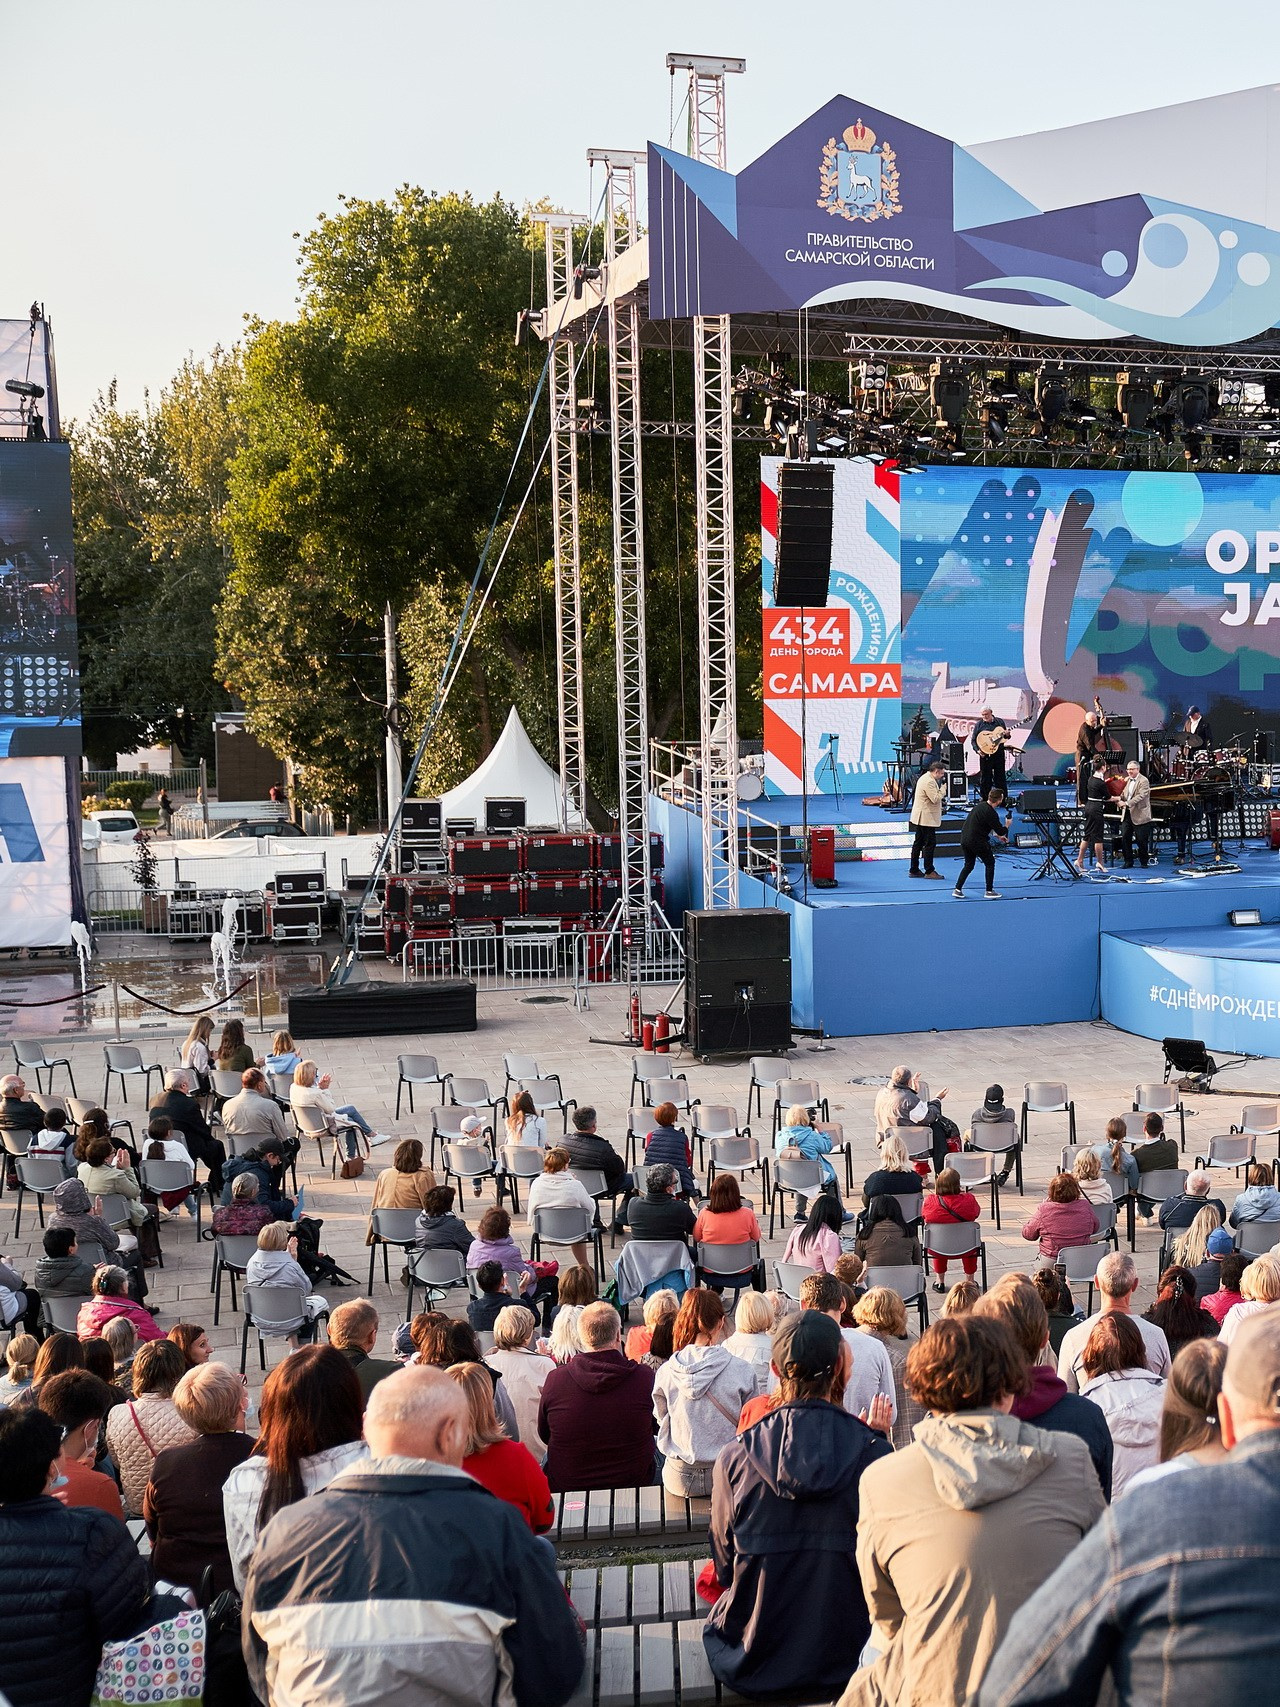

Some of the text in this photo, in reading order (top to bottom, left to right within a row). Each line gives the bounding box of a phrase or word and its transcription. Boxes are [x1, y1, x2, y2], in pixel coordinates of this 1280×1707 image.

[806, 232, 914, 251] ПРАВИТЕЛЬСТВО
[784, 248, 935, 270] САМАРСКОЙ ОБЛАСТИ
[836, 577, 882, 662] РОЖДЕНИЯ!
[769, 616, 844, 646] 434
[769, 648, 799, 657] ДЕНЬ
[769, 672, 899, 694] САМАРА
